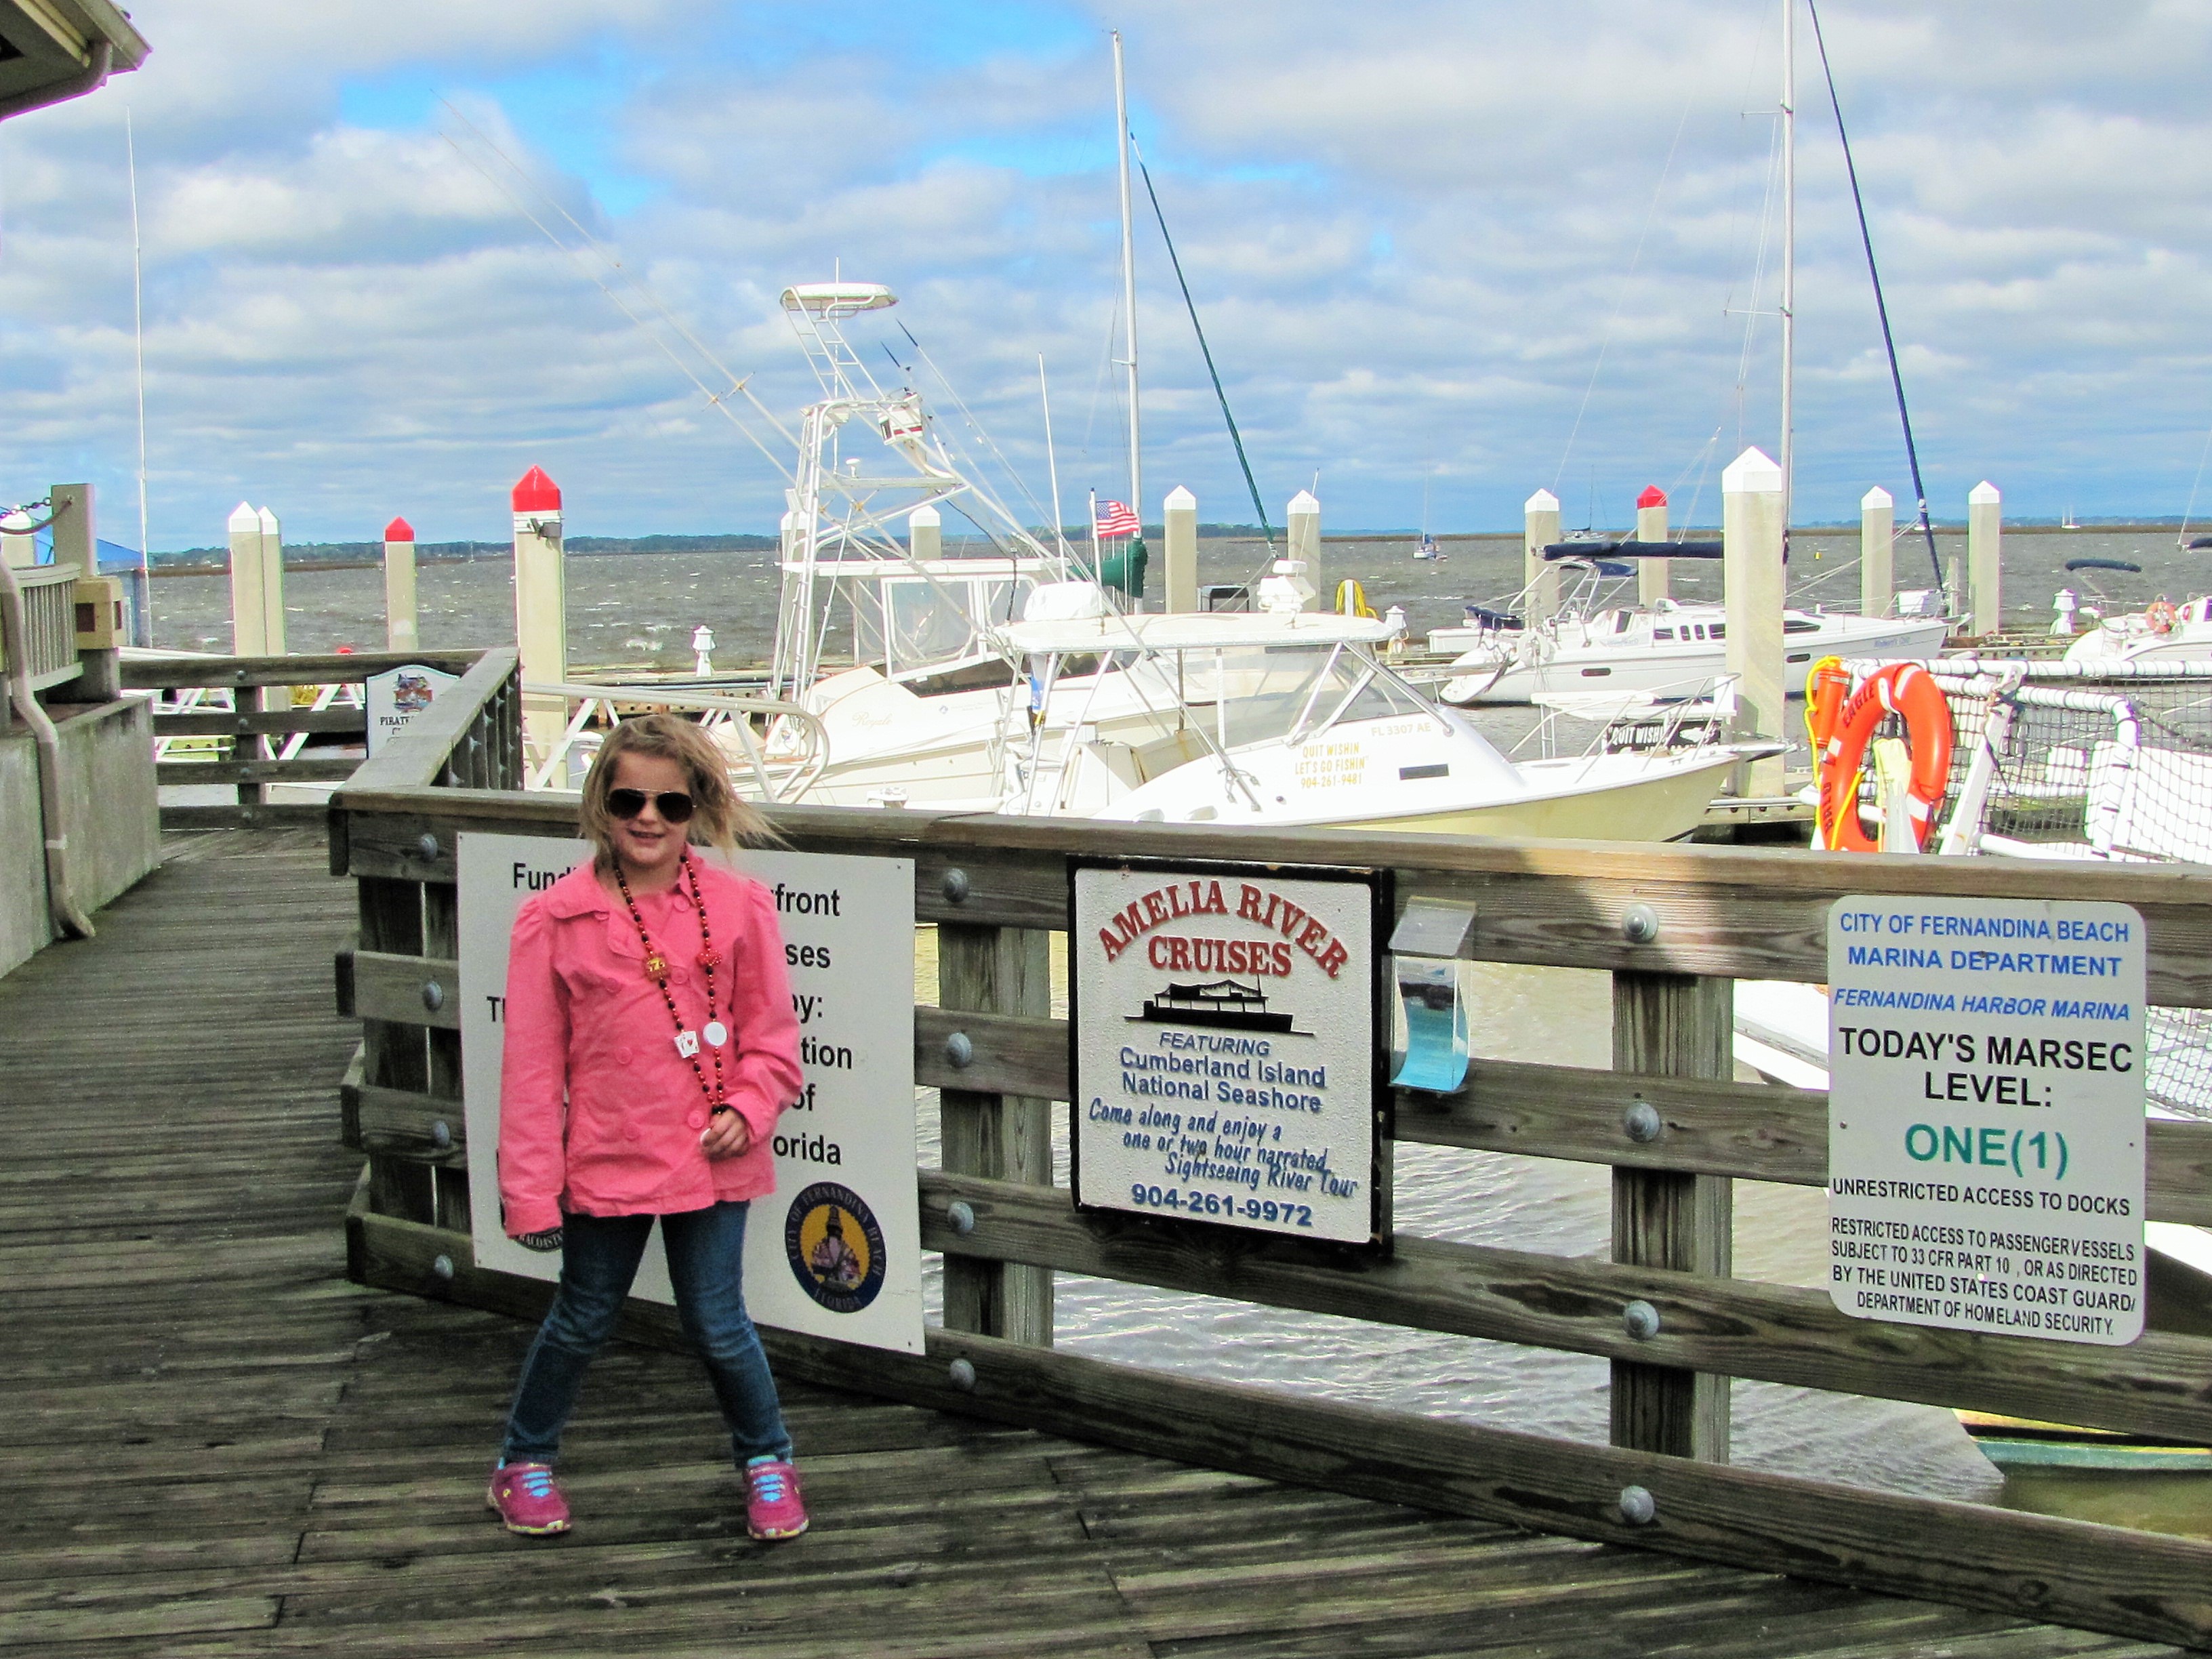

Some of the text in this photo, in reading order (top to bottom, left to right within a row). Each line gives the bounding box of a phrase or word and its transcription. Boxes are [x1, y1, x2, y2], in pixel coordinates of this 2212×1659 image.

[380, 716, 415, 726] PIRATE
[1371, 726, 1385, 737] FL
[1387, 724, 1414, 735] 3307
[1320, 760, 1332, 773] GO
[1327, 742, 1359, 756] WISHIN
[514, 862, 840, 916] Fun front
[1099, 880, 1348, 979] AMELIA RIVER
[1840, 912, 2129, 942] CITY OF FERNANDINA BEACH
[1148, 935, 1292, 977] CRUISES
[1849, 946, 2122, 977] MARINA DEPARTMENT
[487, 994, 822, 1024] T y:
[1835, 988, 2129, 1021] FERNANDINA HARBOR MARINA
[1160, 1032, 1270, 1057] FEATURING
[1839, 1027, 2132, 1073] TODAY'S MARSEC
[1120, 1046, 1328, 1090] Cumberland Island
[1122, 1071, 1323, 1114] National Seashore
[1925, 1071, 2051, 1107] LEVEL:
[1089, 1097, 1282, 1147] Come along and enjoy a
[1122, 1132, 1329, 1172] one or two hour narrated
[1905, 1124, 2068, 1181] ONE(1)
[1164, 1151, 1358, 1199] Sightseeing River Tour
[1131, 1183, 1312, 1227] 904-261-9972
[1833, 1178, 2130, 1216] UNRESTRICTED ACCESS TO DOCKS
[1832, 1217, 2134, 1261] RESTRICTED ACCESS TO PASSENGER VESSELS
[1832, 1240, 1887, 1261] SUBJECT
[1891, 1246, 1908, 1263] TO
[1912, 1248, 1925, 1265] 33
[1928, 1249, 1954, 1267] CFR
[1958, 1252, 1992, 1272] PART
[1996, 1256, 2009, 1274] 10
[2024, 1258, 2043, 1277] OR
[2046, 1261, 2064, 1279] AS
[2068, 1263, 2137, 1286] DIRECTED
[1833, 1265, 1852, 1282] BY
[1857, 1267, 1885, 1286] THE
[1890, 1271, 1945, 1292] UNITED
[1950, 1277, 2008, 1300] STATES
[2013, 1284, 2068, 1305] COAST
[1857, 1291, 2112, 1335] DEPARTMENT OF HOMELAND SECURITY.
